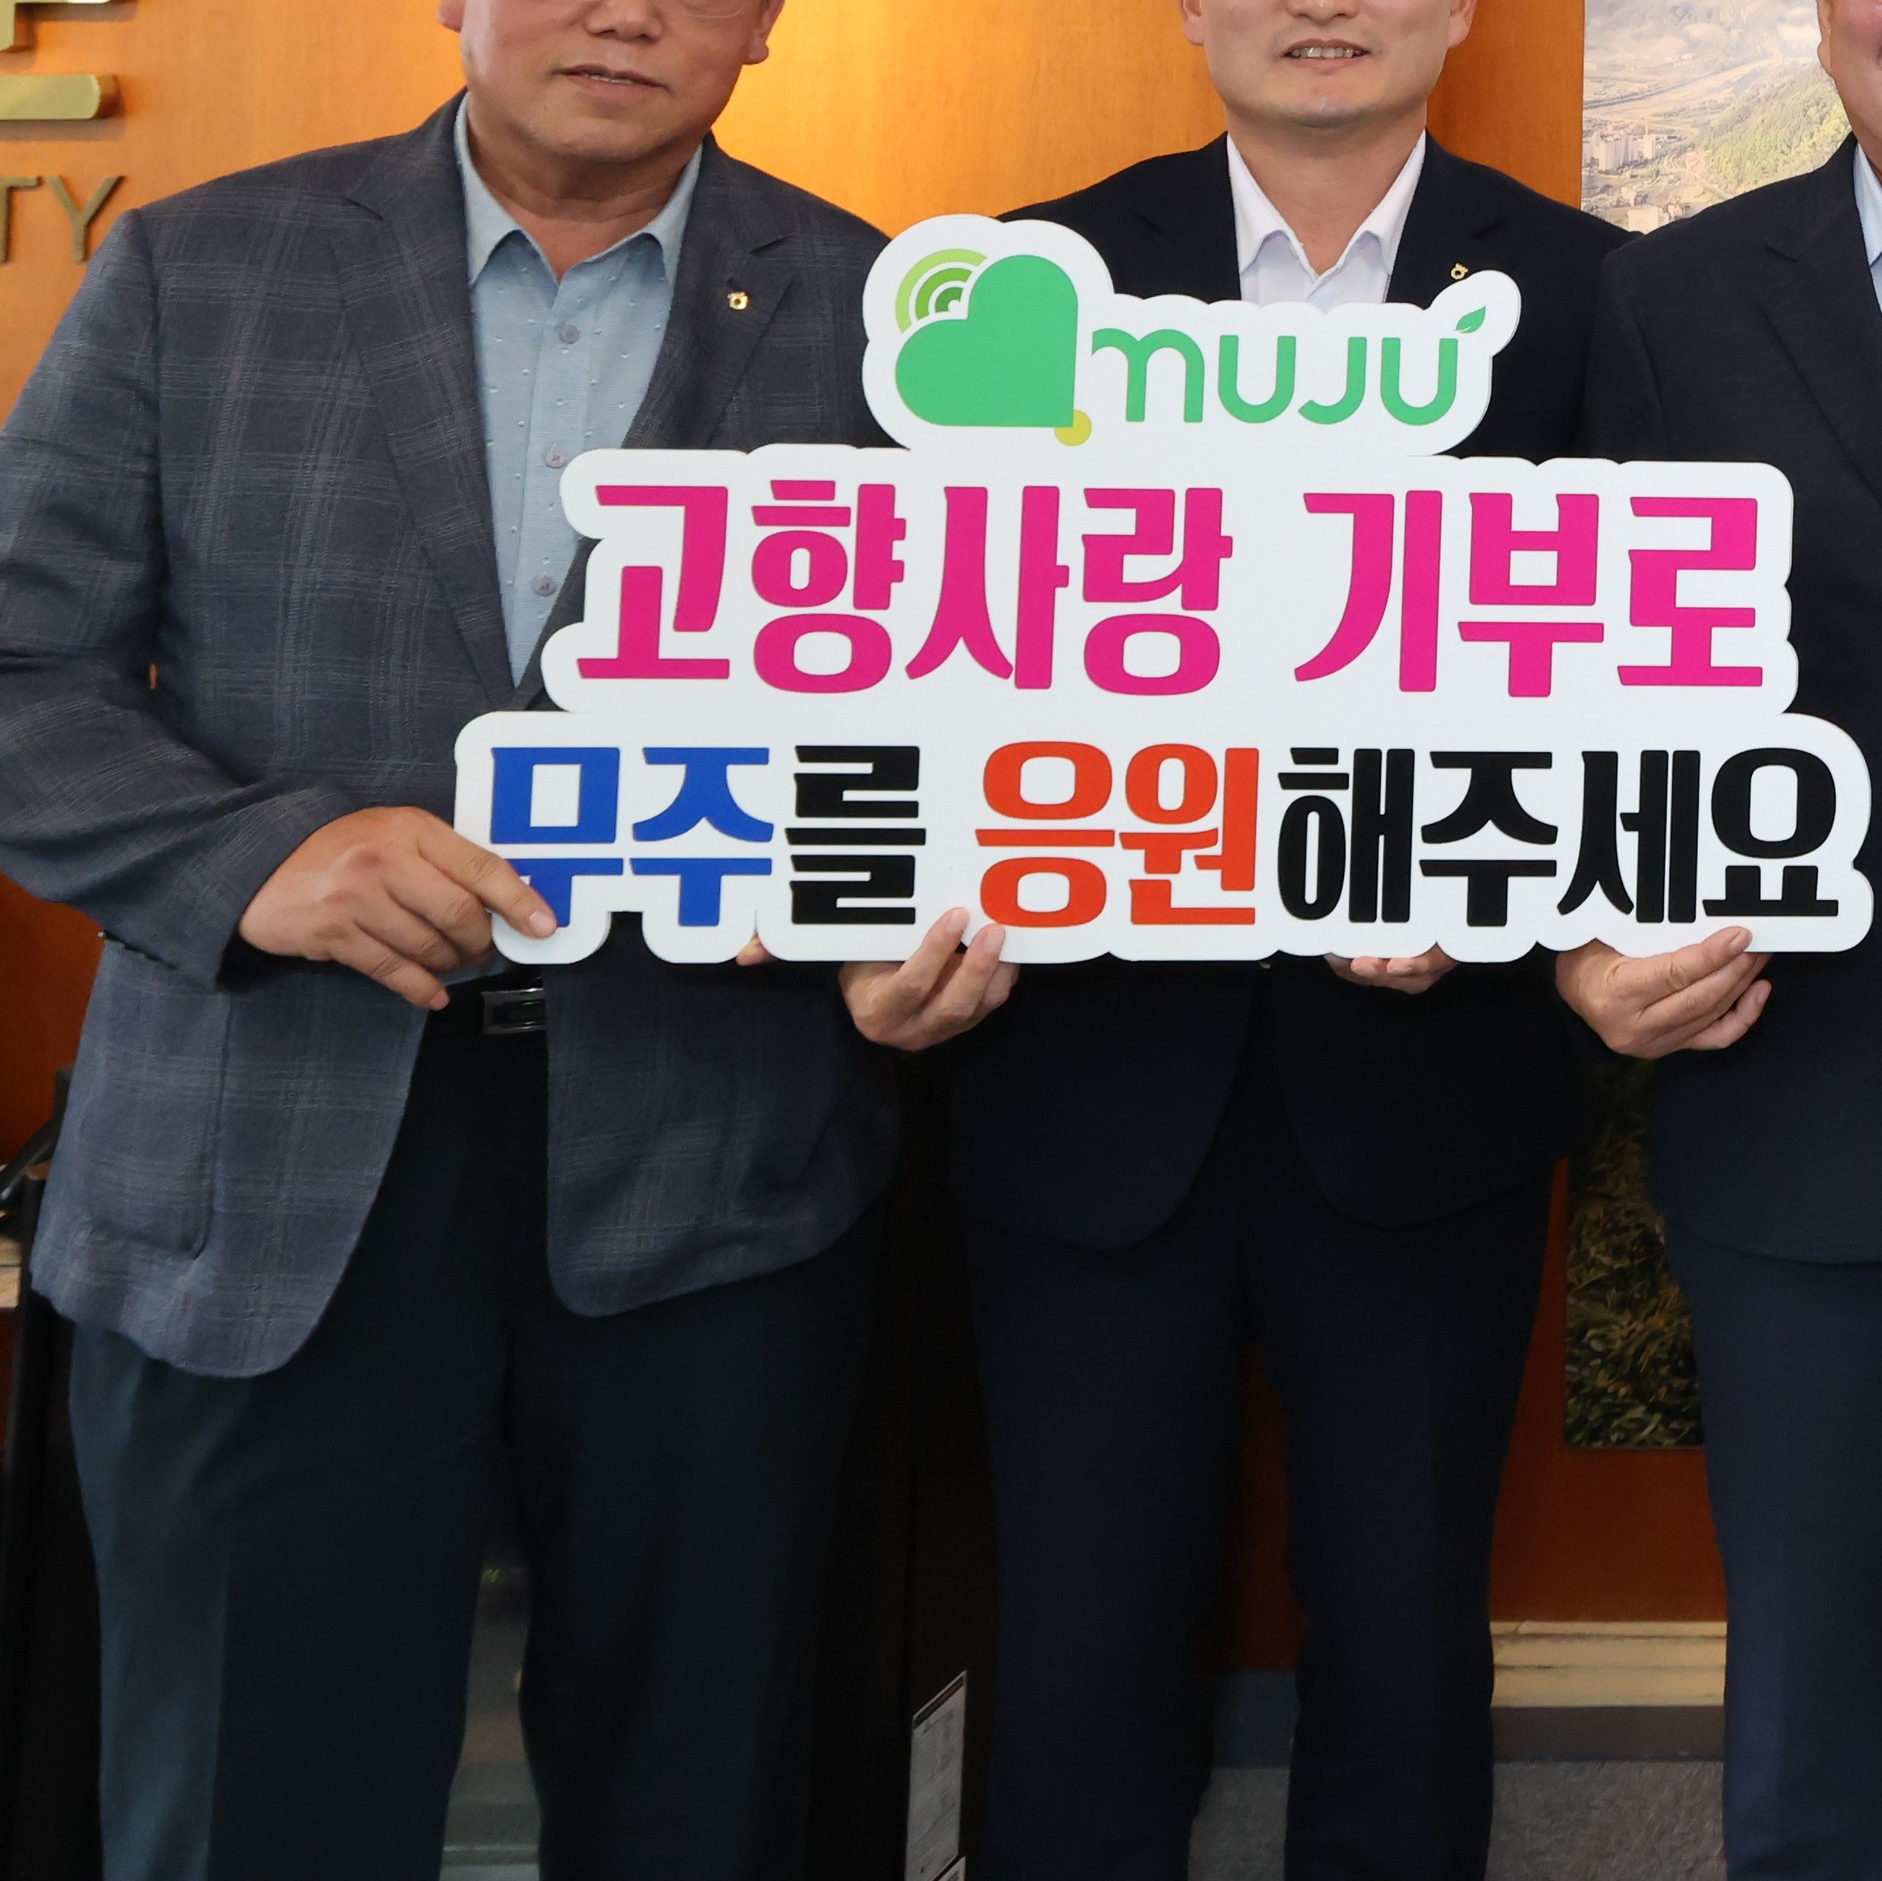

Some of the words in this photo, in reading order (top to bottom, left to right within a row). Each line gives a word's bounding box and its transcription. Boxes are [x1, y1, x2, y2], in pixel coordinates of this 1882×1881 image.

[579, 481, 1232, 695] 고향사랑
[1296, 491, 1762, 697] 기부로
[490, 746, 926, 927] 무주를
[974, 743, 1838, 926] 응원해주세요
